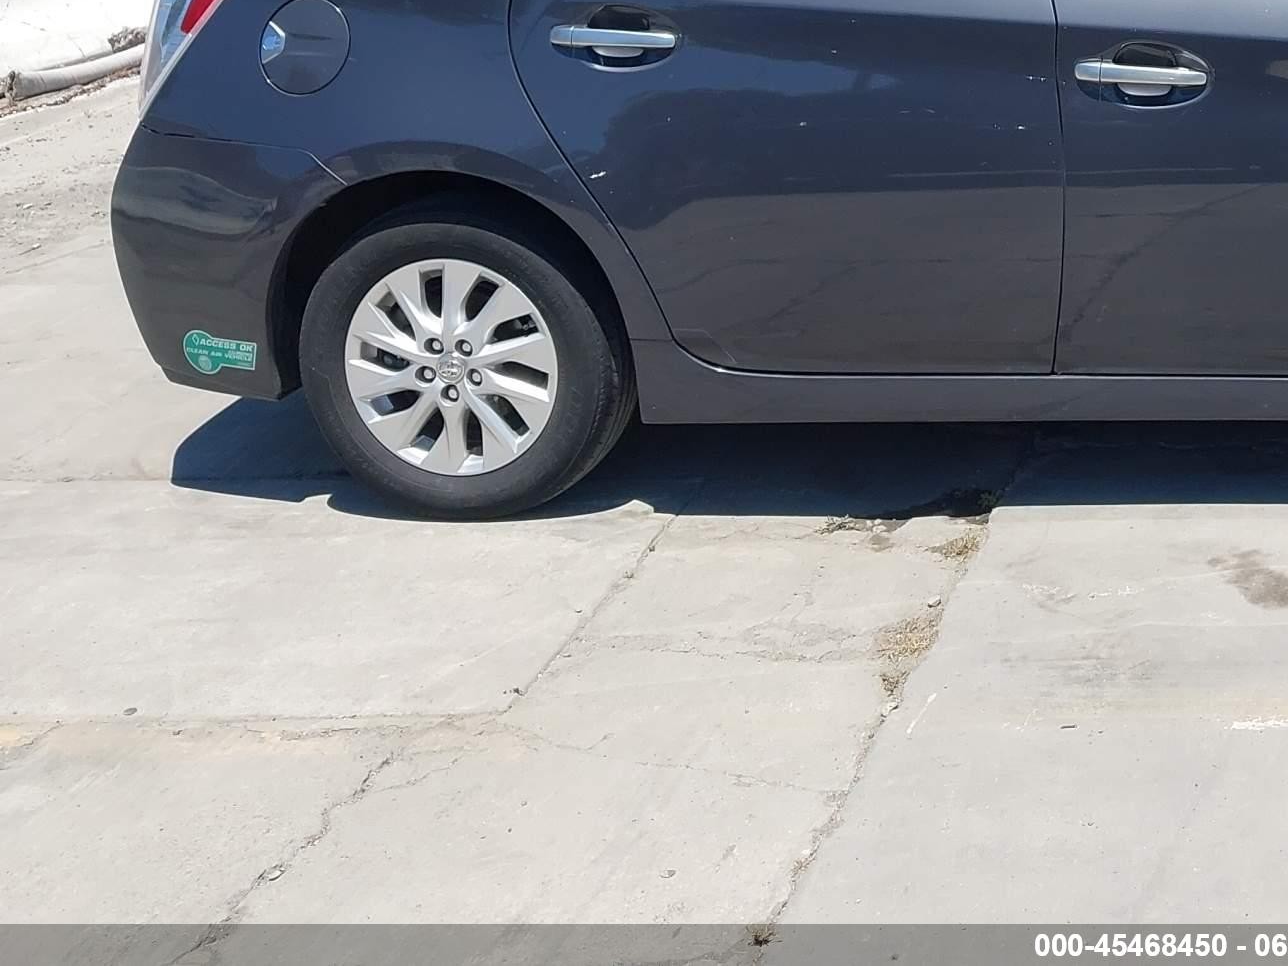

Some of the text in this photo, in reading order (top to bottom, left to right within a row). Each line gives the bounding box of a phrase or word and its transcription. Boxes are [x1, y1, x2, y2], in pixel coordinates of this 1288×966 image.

[200, 338, 236, 350] ACCESS
[239, 344, 253, 352] OK
[186, 347, 209, 355] CLEAN
[224, 353, 253, 361] VEHICLE
